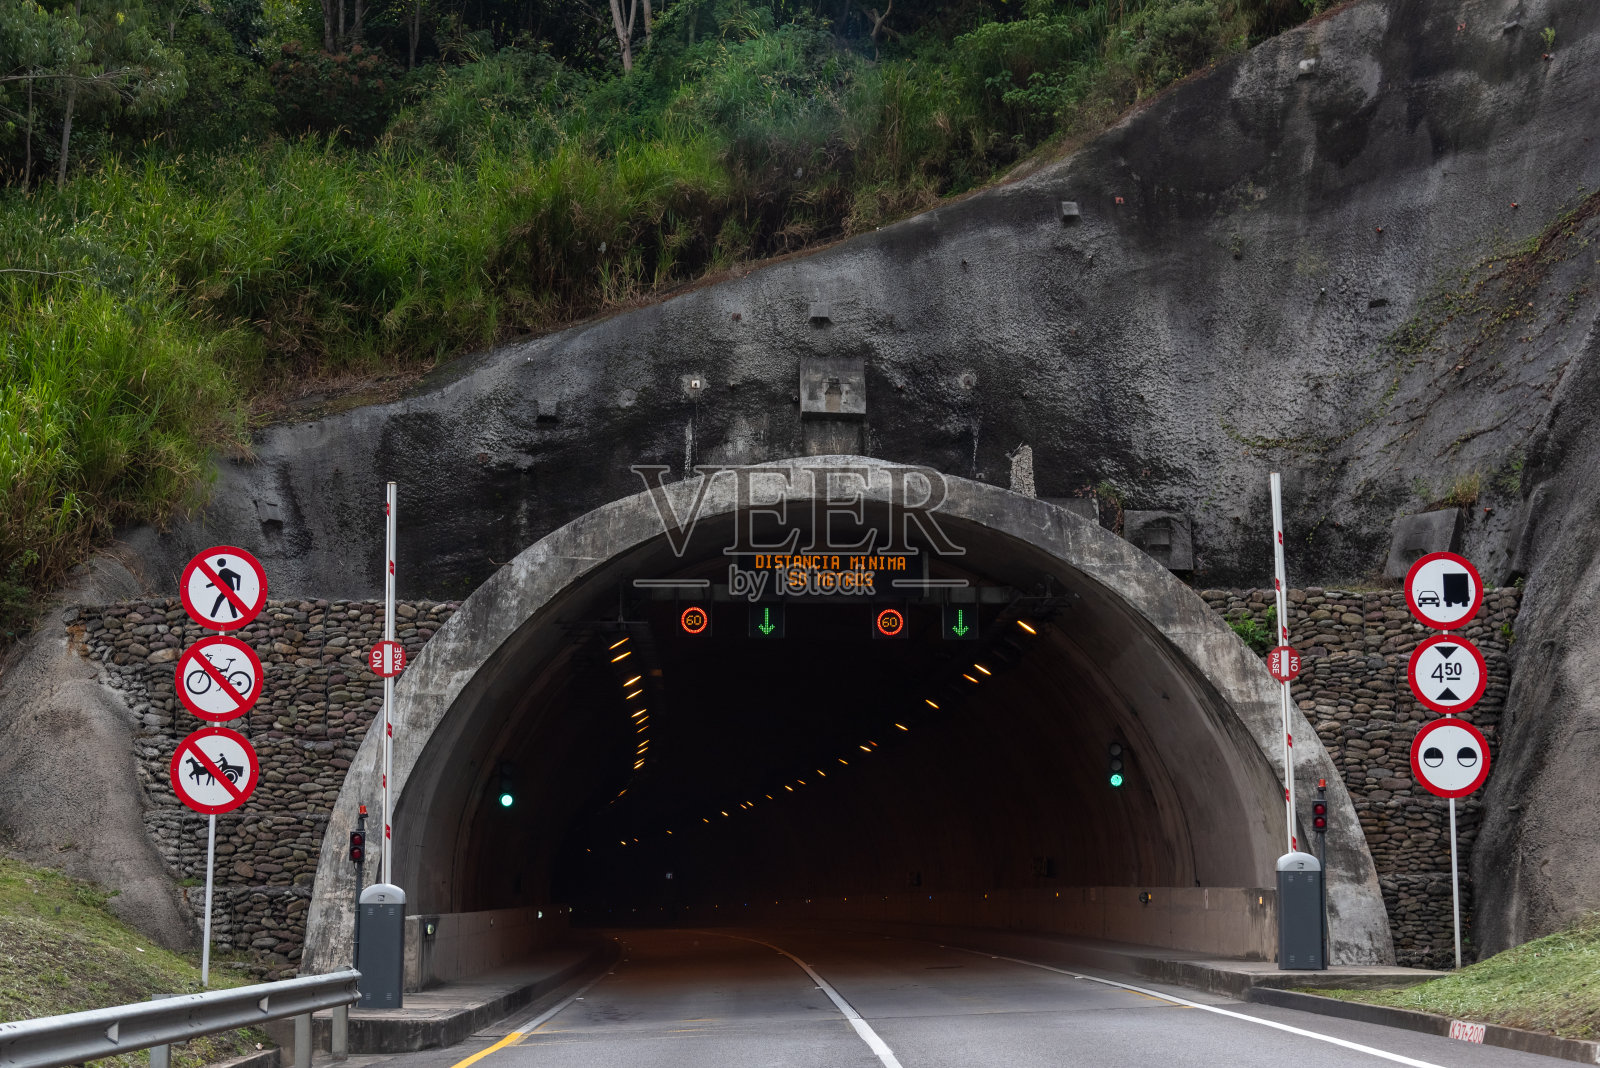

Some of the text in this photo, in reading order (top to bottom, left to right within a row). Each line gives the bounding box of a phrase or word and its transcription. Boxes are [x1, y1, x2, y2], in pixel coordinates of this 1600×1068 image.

[756, 555, 906, 570] DISTANCIA MINIMA
[817, 572, 874, 586] METROS
[685, 614, 702, 626] 60
[881, 616, 898, 628] 60
[372, 650, 382, 668] NO
[394, 646, 403, 671] PASE
[1272, 652, 1280, 674] PASE
[1290, 656, 1299, 672] NO
